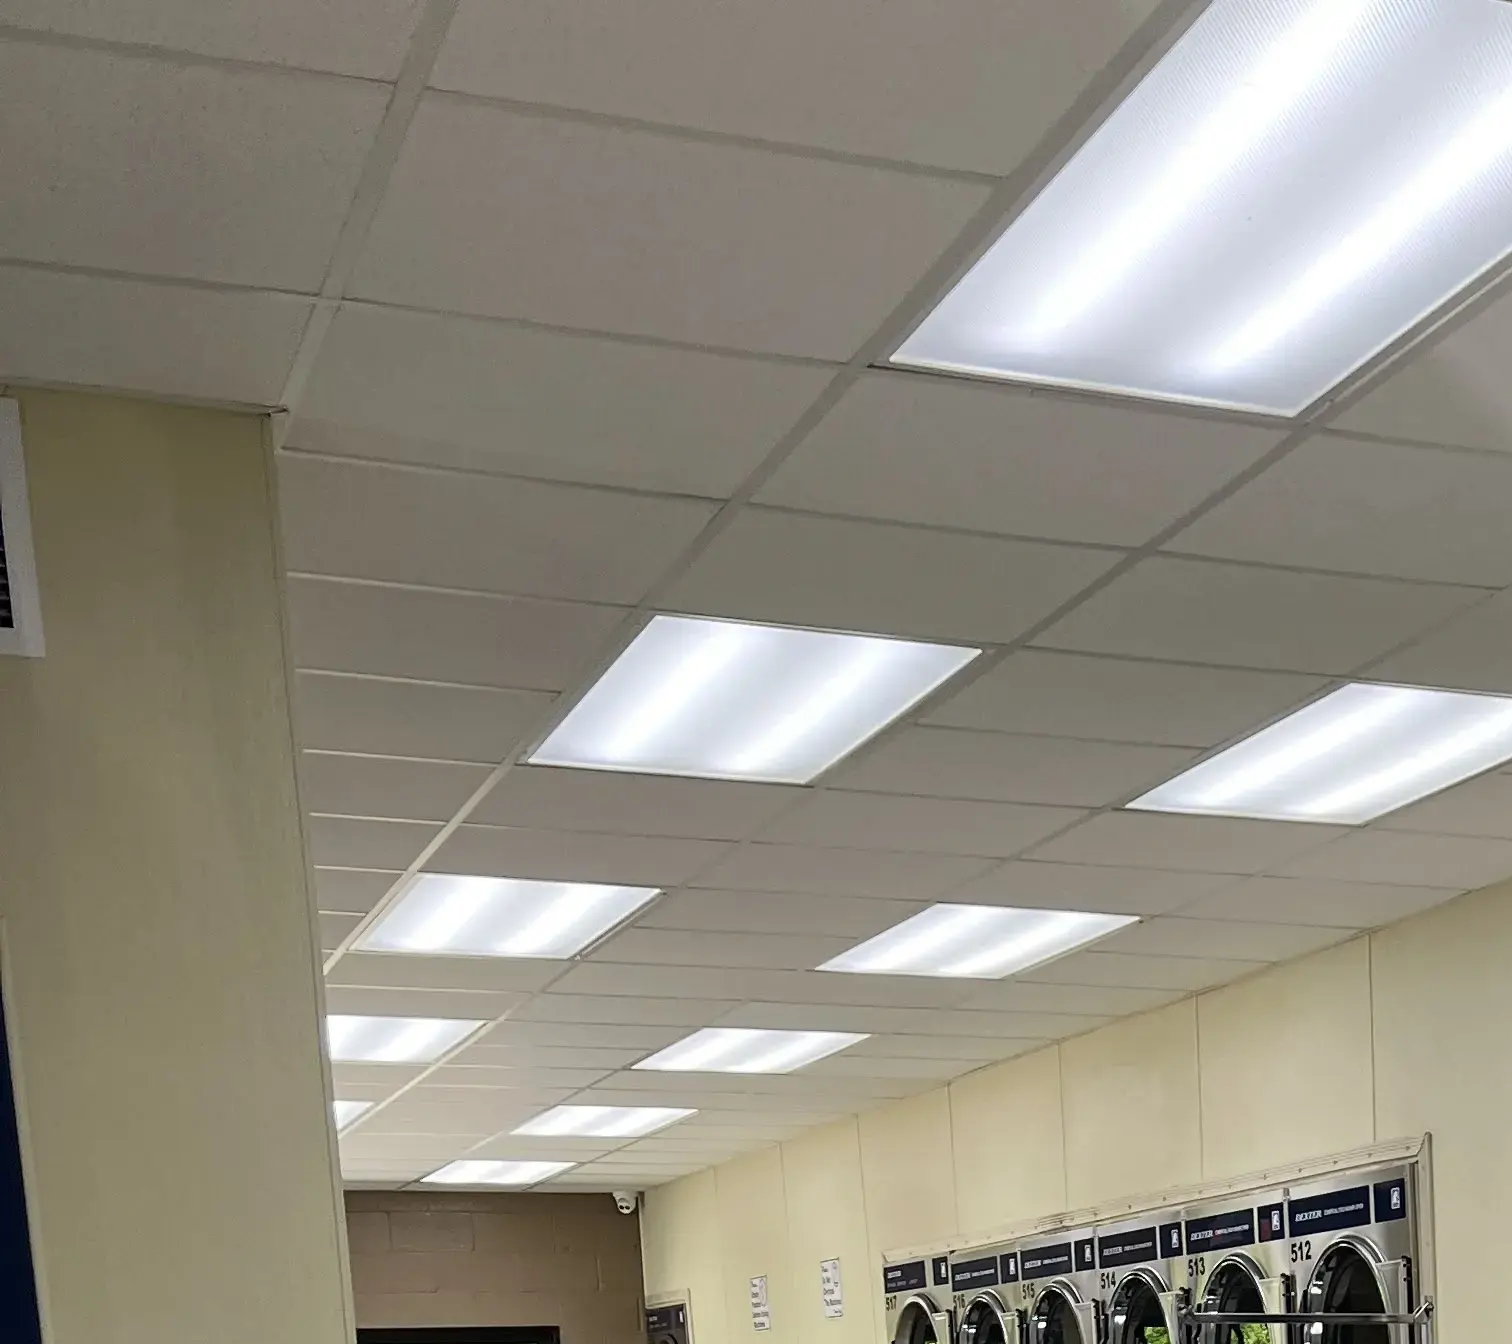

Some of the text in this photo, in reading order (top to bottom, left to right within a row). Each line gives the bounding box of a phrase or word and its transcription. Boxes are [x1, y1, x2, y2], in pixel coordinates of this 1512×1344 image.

[1291, 1240, 1312, 1263] 512
[1188, 1257, 1206, 1277] 513
[1100, 1271, 1117, 1290] 514
[1022, 1283, 1035, 1300] 515
[885, 1295, 897, 1312] 517
[953, 1294, 966, 1310] 516
